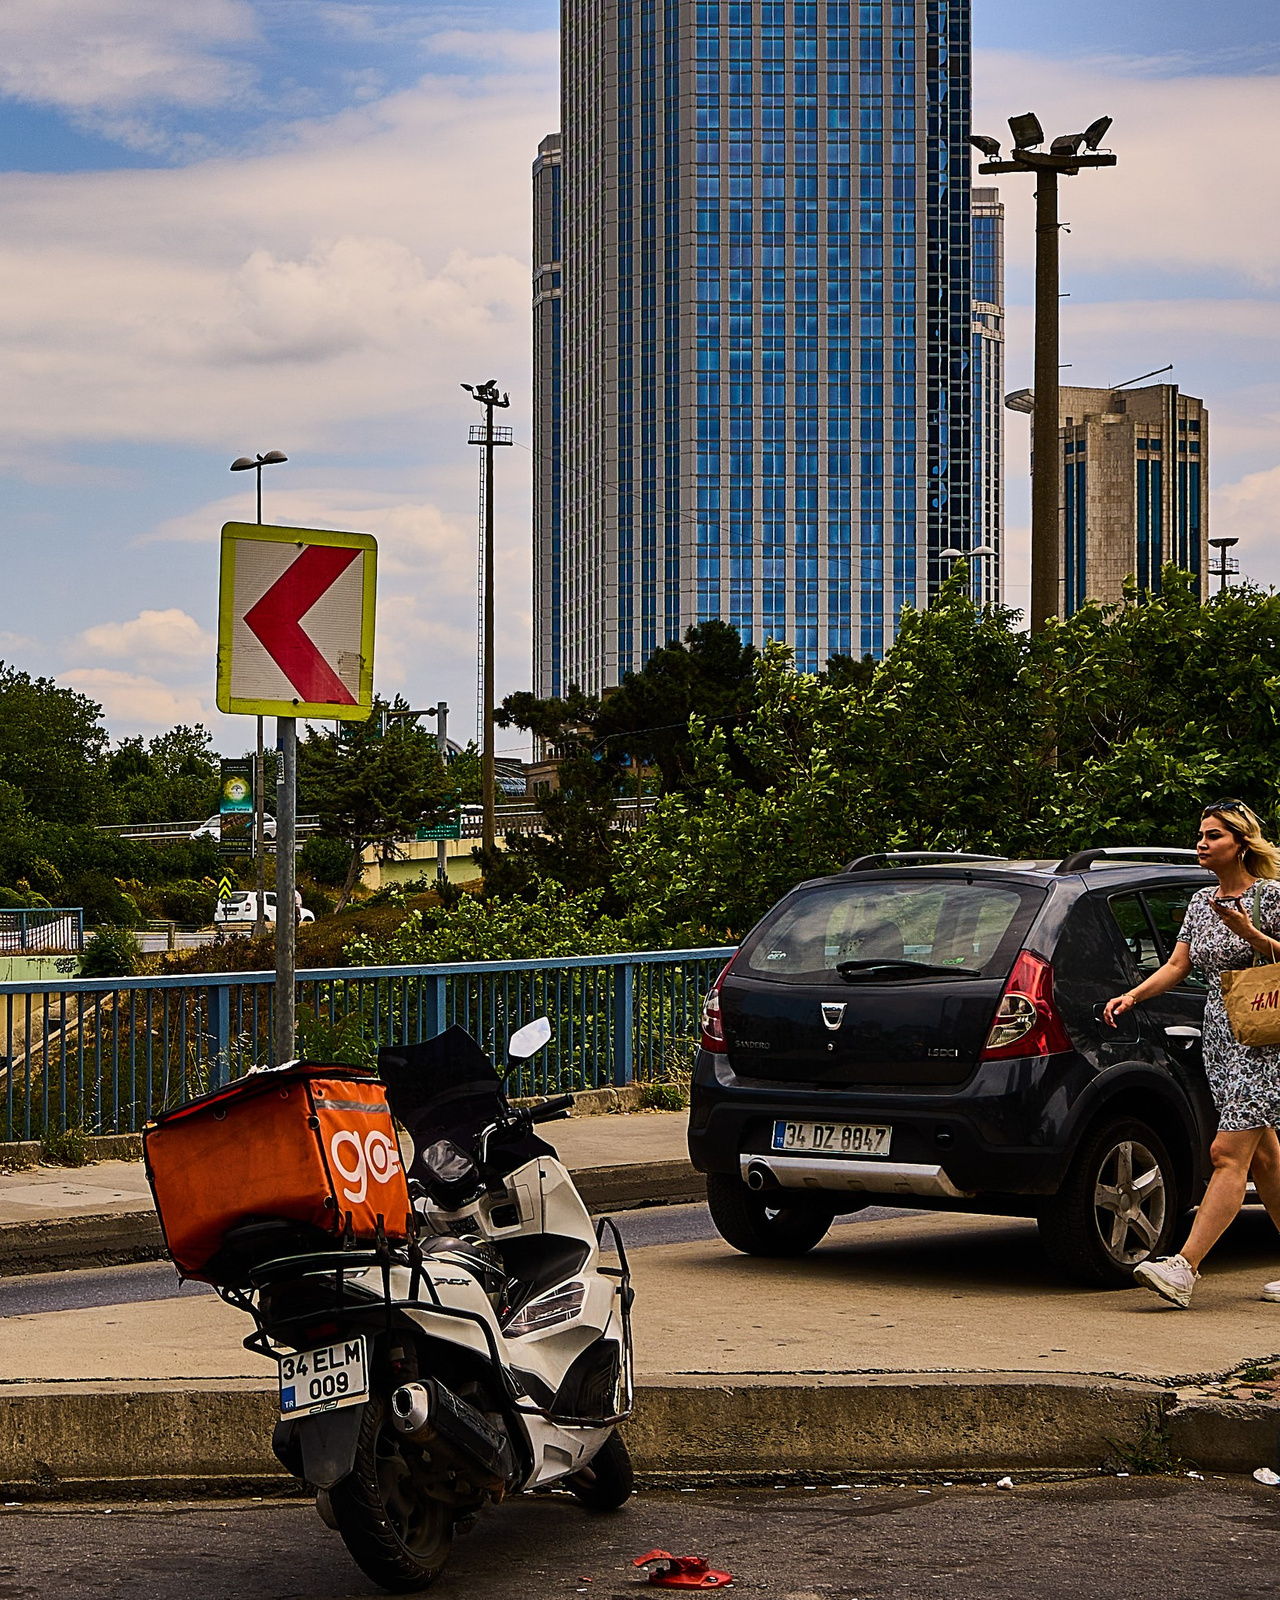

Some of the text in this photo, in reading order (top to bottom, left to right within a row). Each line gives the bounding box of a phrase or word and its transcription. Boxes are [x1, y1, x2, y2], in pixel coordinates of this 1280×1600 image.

[735, 1040, 770, 1050] SANDERO
[786, 1124, 805, 1147] 34
[283, 1341, 360, 1380] 34 ELM
[309, 1372, 348, 1400] 009
[284, 1400, 294, 1409] TR
